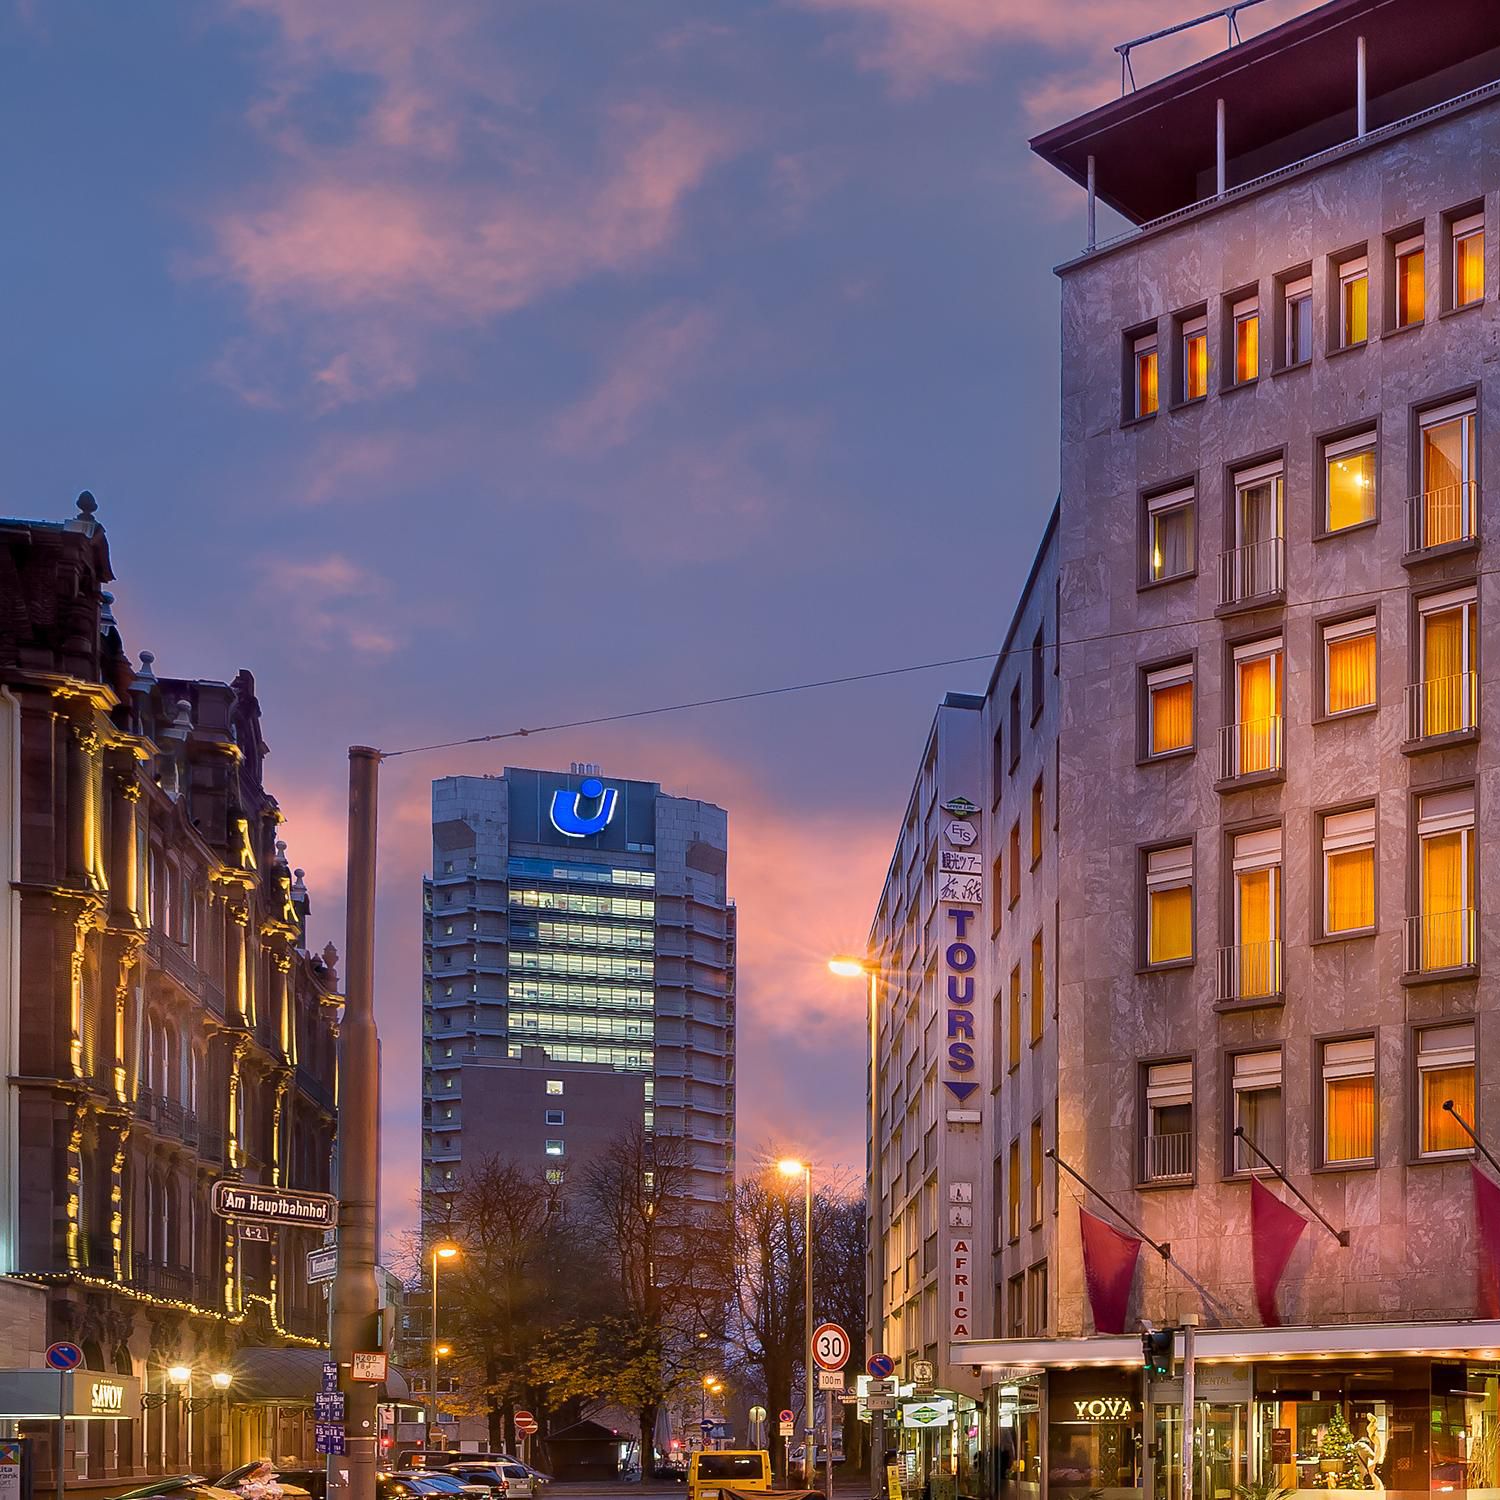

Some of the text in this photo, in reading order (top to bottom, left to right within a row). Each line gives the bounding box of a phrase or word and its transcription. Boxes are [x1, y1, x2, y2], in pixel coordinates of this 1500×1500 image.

[952, 824, 971, 842] ETS
[946, 908, 976, 1073] TOURS
[225, 1192, 328, 1219] Am Hauptbahnhof
[245, 1227, 263, 1239] 4-2
[953, 1241, 969, 1336] AFRICA
[820, 1336, 842, 1357] 30
[92, 1383, 123, 1409] SAVOY
